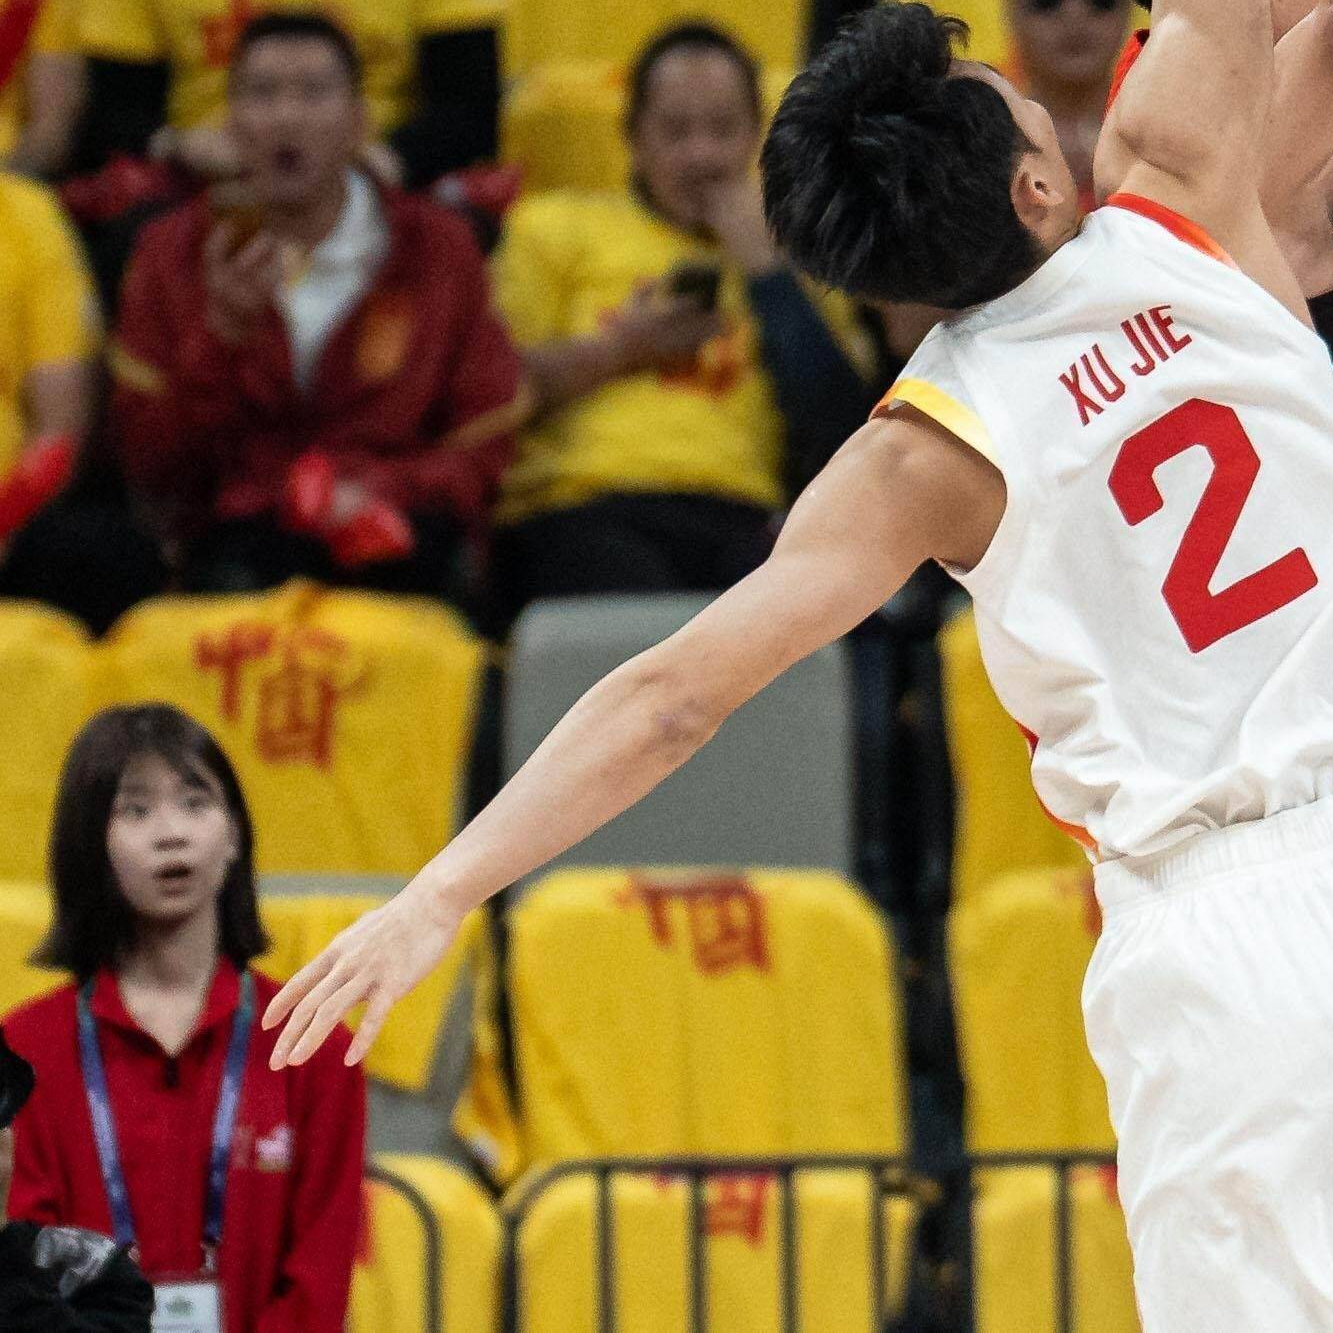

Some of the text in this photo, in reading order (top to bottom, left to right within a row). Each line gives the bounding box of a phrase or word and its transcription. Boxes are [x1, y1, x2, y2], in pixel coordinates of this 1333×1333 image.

[1058, 304, 1193, 427] XU JIE
[1107, 397, 1319, 654] 2
